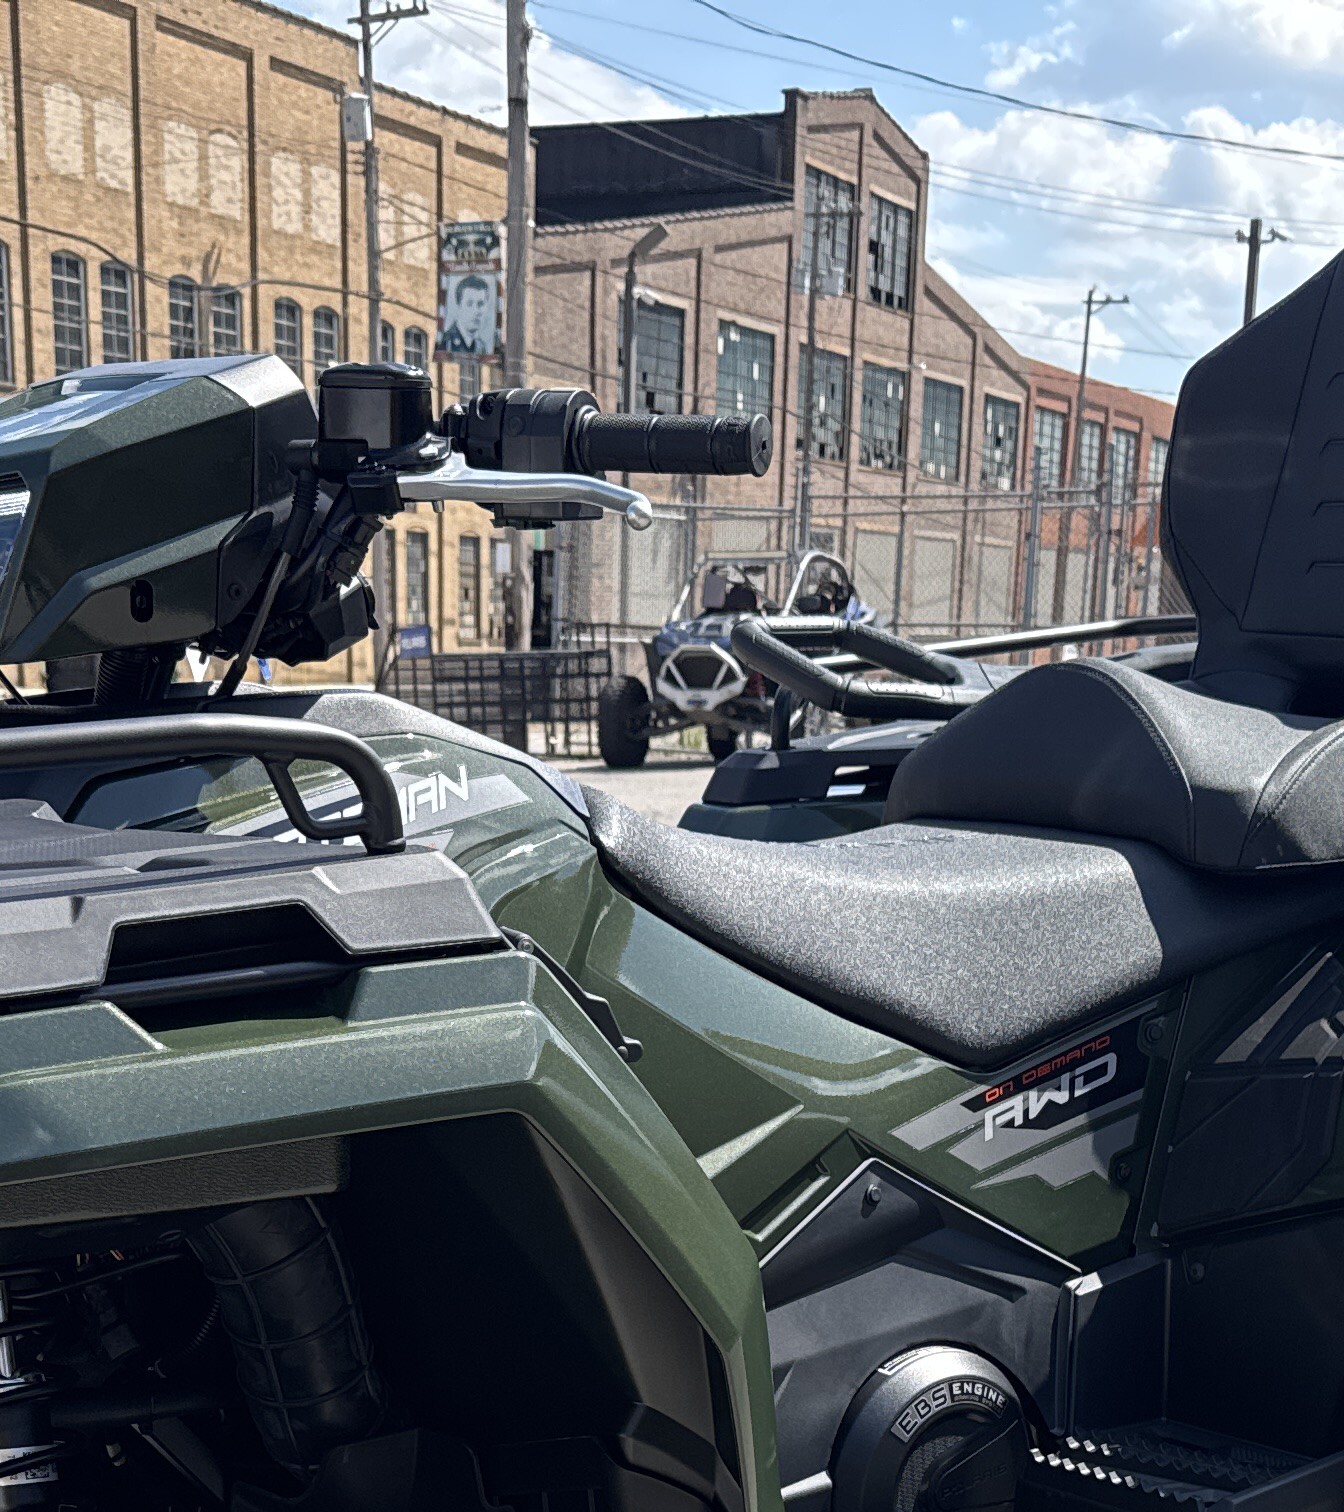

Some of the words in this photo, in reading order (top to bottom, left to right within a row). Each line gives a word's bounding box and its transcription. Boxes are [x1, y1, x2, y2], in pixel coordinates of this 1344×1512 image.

[984, 1052, 1117, 1142] AWD
[897, 1386, 948, 1436] EBS
[952, 1382, 1005, 1408] ENGINE
